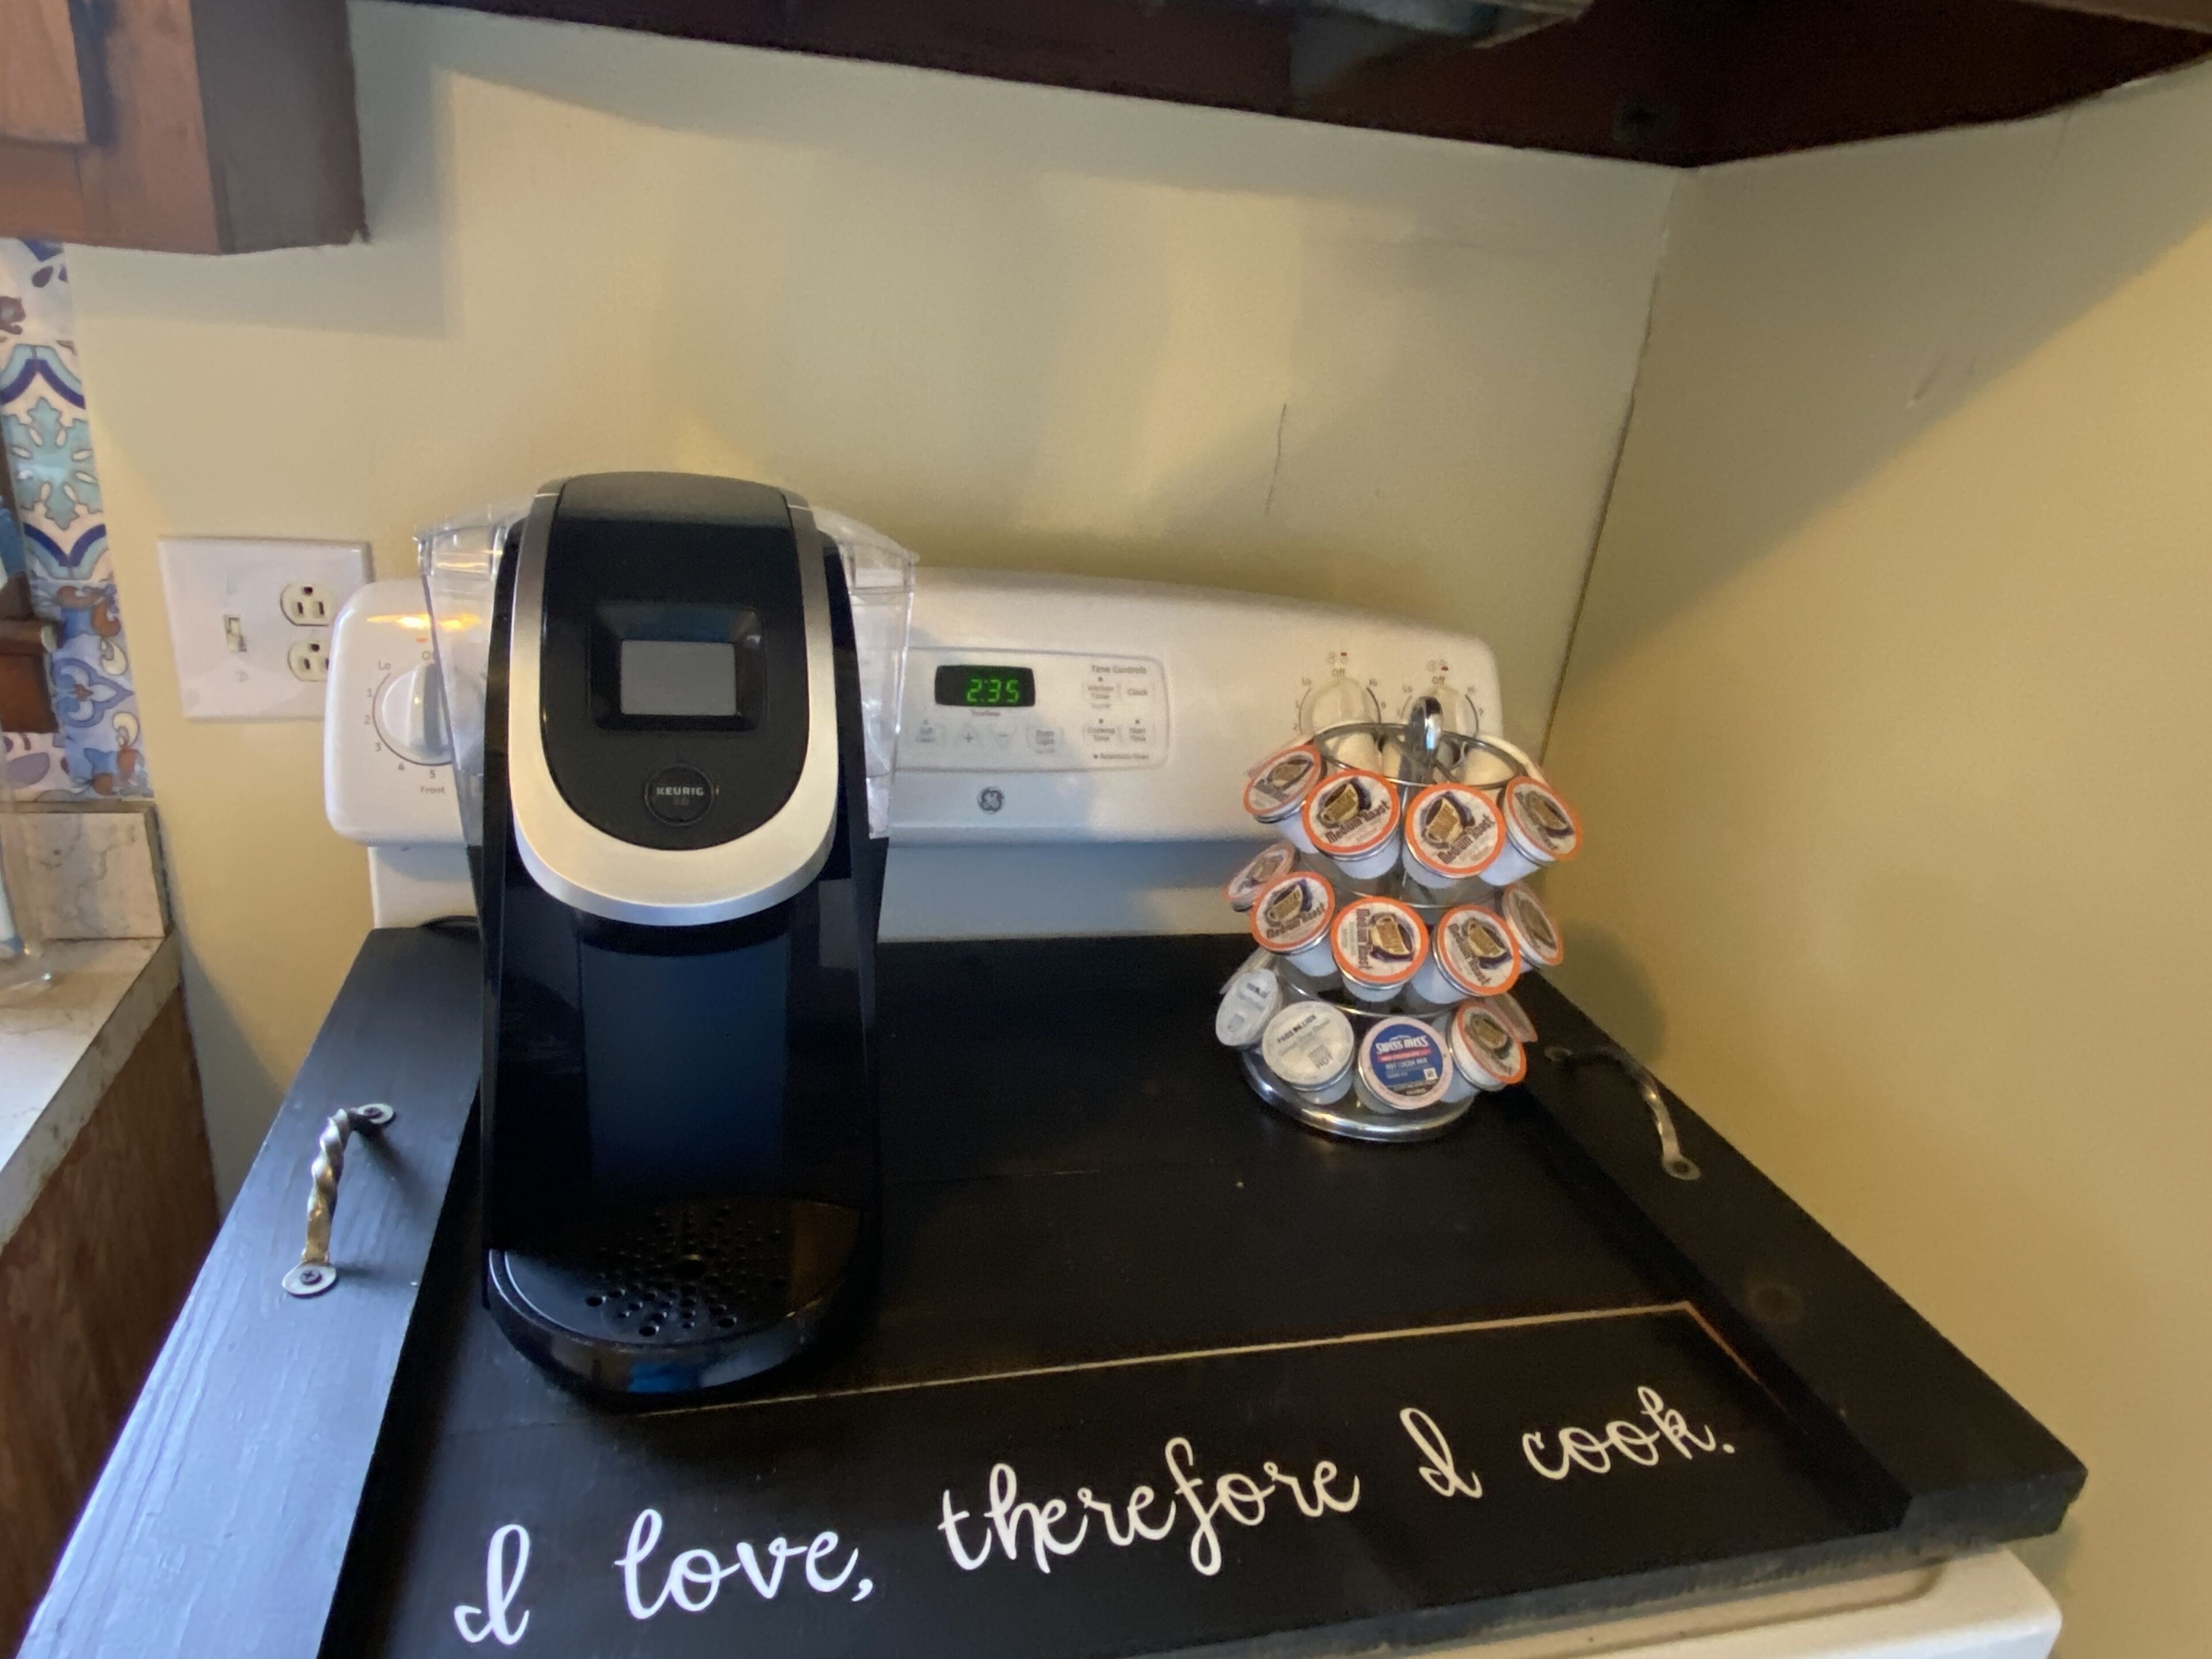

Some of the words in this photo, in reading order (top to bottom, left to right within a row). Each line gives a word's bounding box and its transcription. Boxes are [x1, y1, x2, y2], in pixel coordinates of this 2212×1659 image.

[378, 660, 391, 671] Lo
[1332, 668, 1346, 677] Off
[1432, 675, 1445, 685] Off
[367, 688, 373, 697] 1
[966, 679, 1019, 703] 2:35
[365, 715, 370, 724] 2
[375, 743, 381, 752] 3
[429, 770, 435, 778] 5
[421, 786, 445, 794] Front
[656, 786, 704, 796] KEURIG
[1325, 817, 1363, 844] Medium
[1359, 800, 1391, 823] Roast
[1437, 830, 1474, 865] Medium
[1468, 814, 1495, 841] Roast
[1300, 902, 1326, 924] Roast
[612, 1508, 874, 1620] love,
[937, 1437, 1361, 1576] therefore
[1522, 1385, 1735, 1480] cook.
